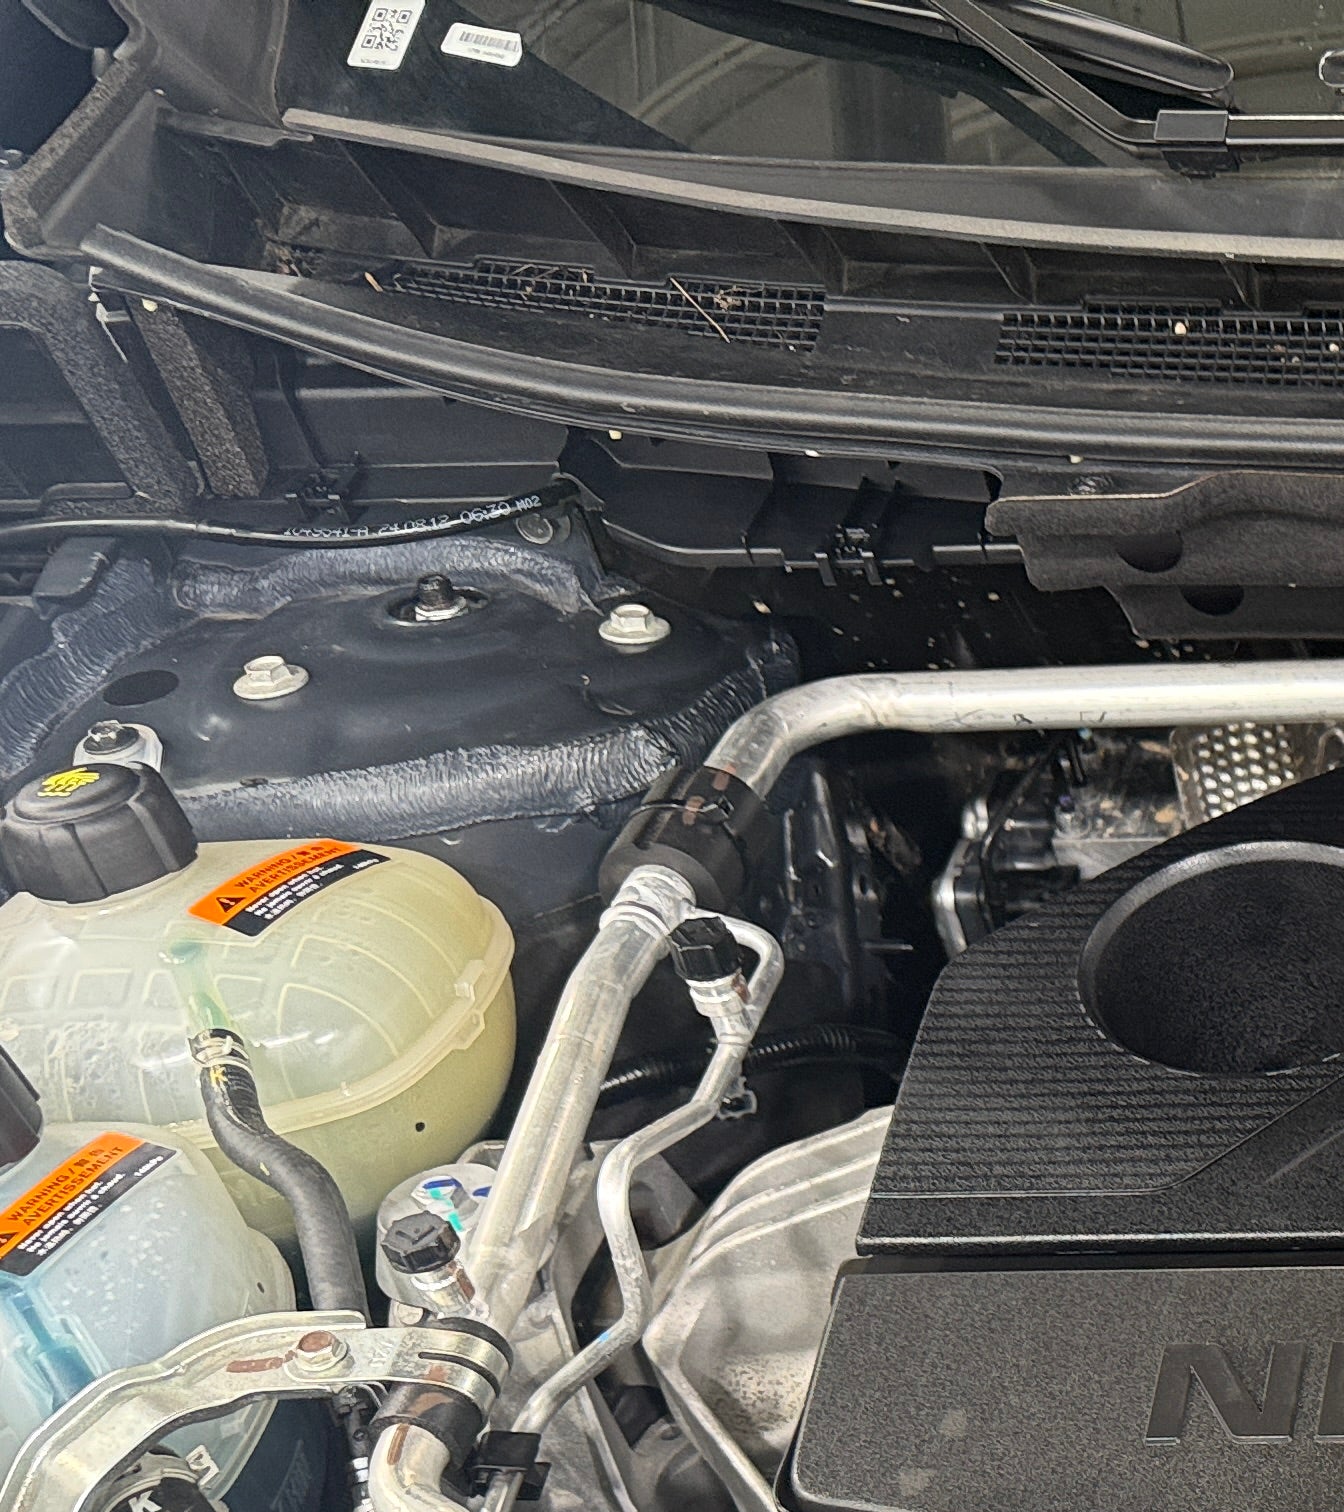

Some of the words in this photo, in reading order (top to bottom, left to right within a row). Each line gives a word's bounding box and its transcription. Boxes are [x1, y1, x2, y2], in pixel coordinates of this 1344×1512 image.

[235, 858, 291, 889] WARNING
[8, 1174, 70, 1222] WARNING
[23, 1146, 124, 1226] AVERTISSEMENT
